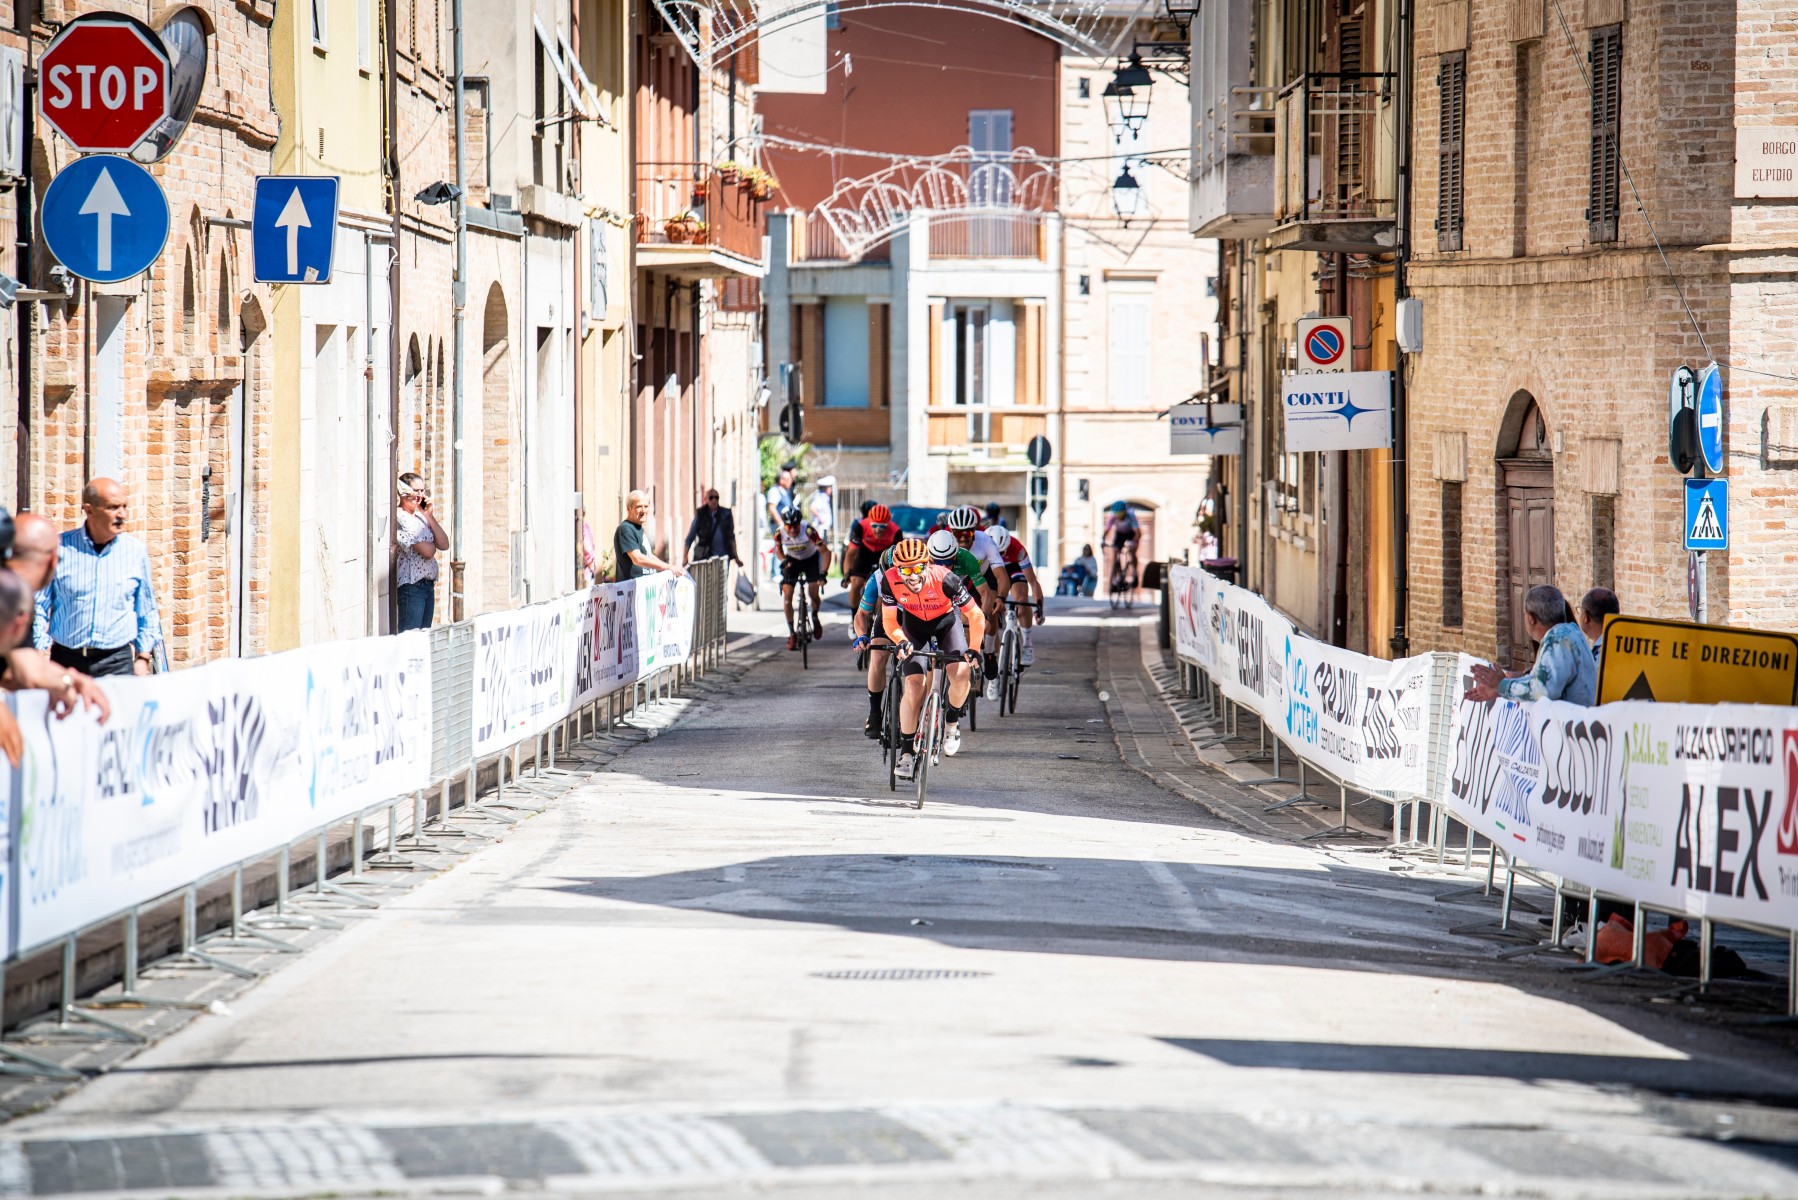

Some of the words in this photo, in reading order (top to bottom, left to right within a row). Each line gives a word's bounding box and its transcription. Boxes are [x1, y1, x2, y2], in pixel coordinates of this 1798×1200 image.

[49, 64, 158, 110] STOP
[1762, 142, 1796, 154] BORGO
[1752, 168, 1793, 181] ELPIDIO
[1287, 391, 1344, 406] CONTI
[1171, 417, 1208, 425] CONT
[1615, 635, 1660, 657] TUTTE
[1672, 641, 1689, 660] LE
[1701, 645, 1790, 671] DIREZIONI
[1675, 724, 1774, 765] CALZATURIFICIO
[1670, 782, 1773, 902] ALEX
